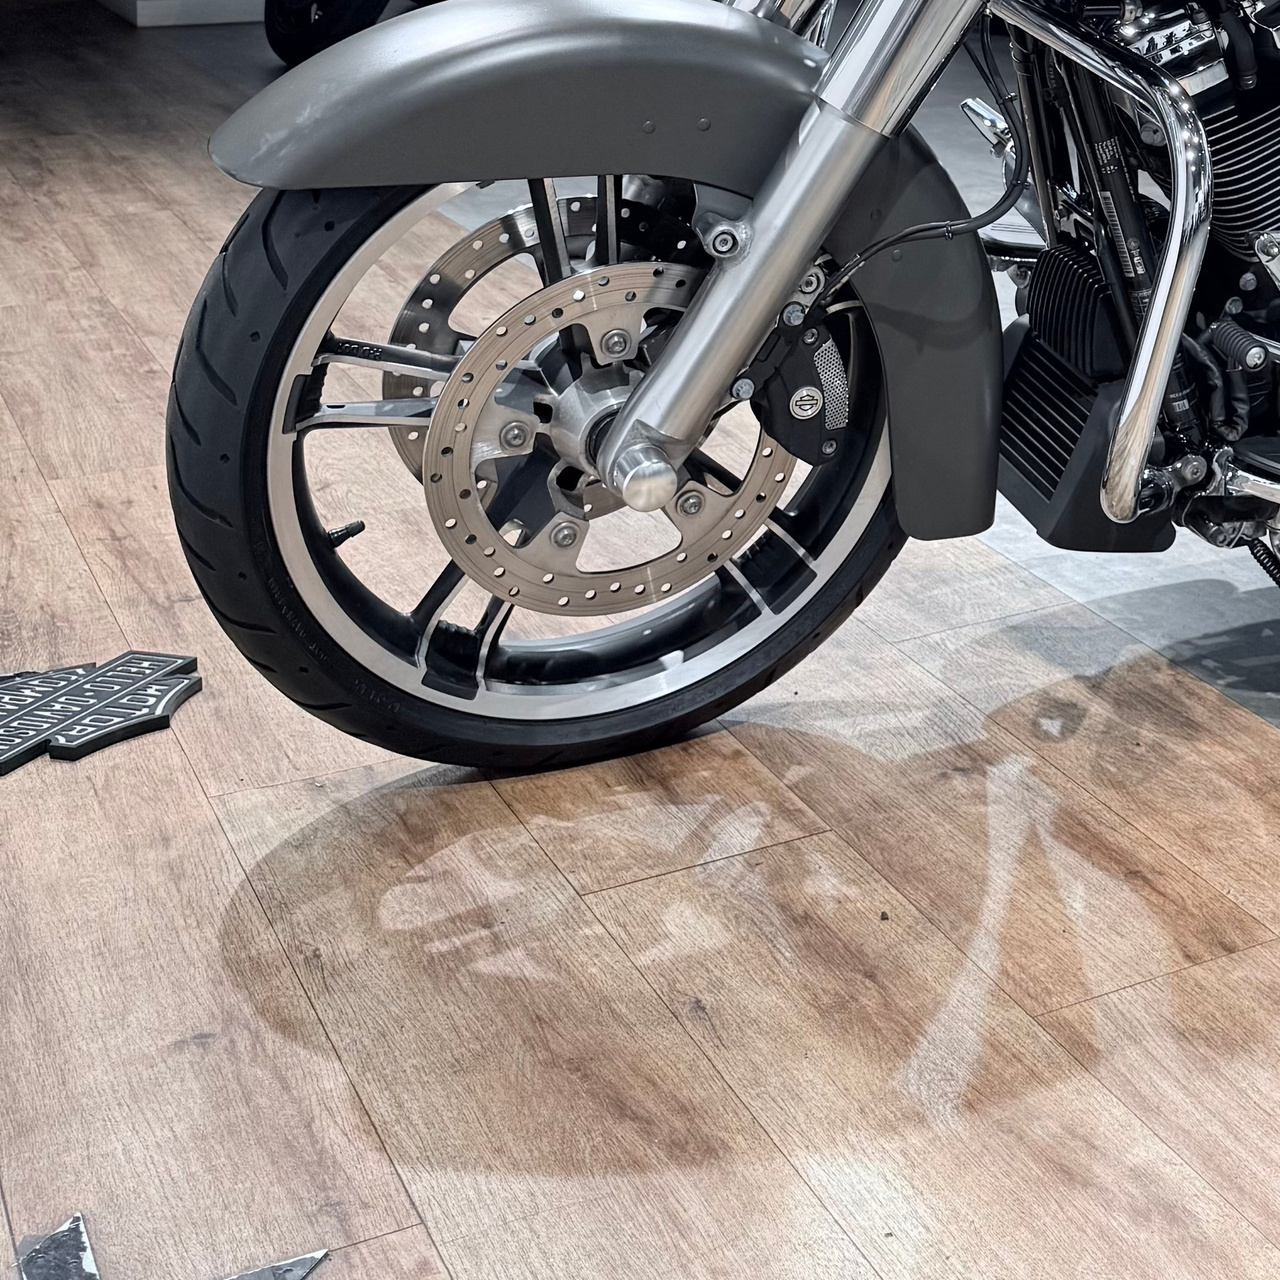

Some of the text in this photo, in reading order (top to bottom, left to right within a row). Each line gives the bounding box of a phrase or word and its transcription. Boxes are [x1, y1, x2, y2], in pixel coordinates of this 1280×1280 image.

[0, 659, 165, 749] HELLO DAVIDSO
[62, 682, 169, 736] MOTOR
